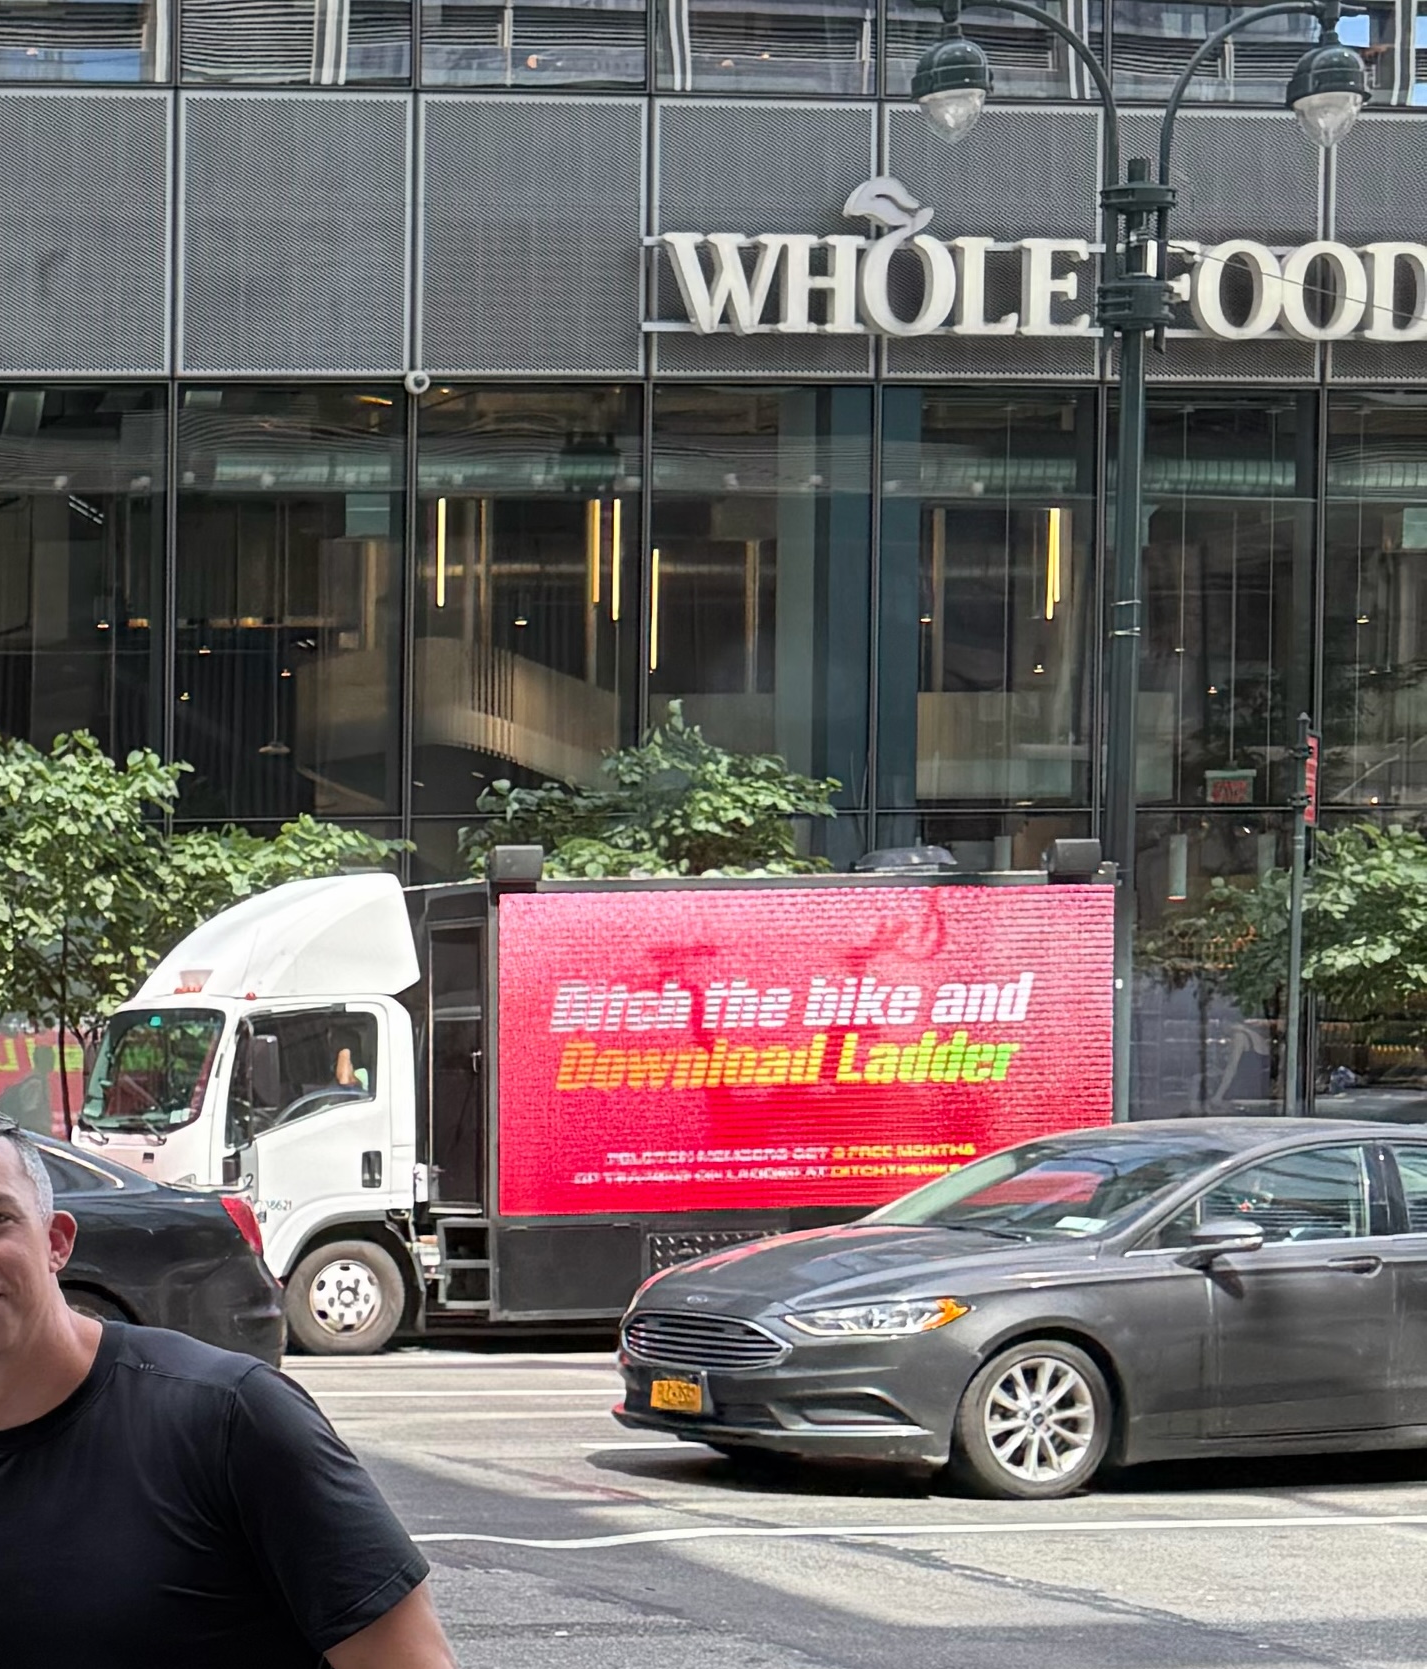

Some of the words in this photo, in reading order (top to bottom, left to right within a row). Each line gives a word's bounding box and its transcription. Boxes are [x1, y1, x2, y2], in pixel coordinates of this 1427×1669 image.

[662, 228, 1091, 338] WHOLE
[550, 979, 692, 1032] Ditch
[701, 977, 793, 1029] the
[803, 976, 923, 1026] bike
[932, 971, 1035, 1022] and
[555, 1033, 827, 1090] Download
[837, 1030, 1021, 1083] Ladder
